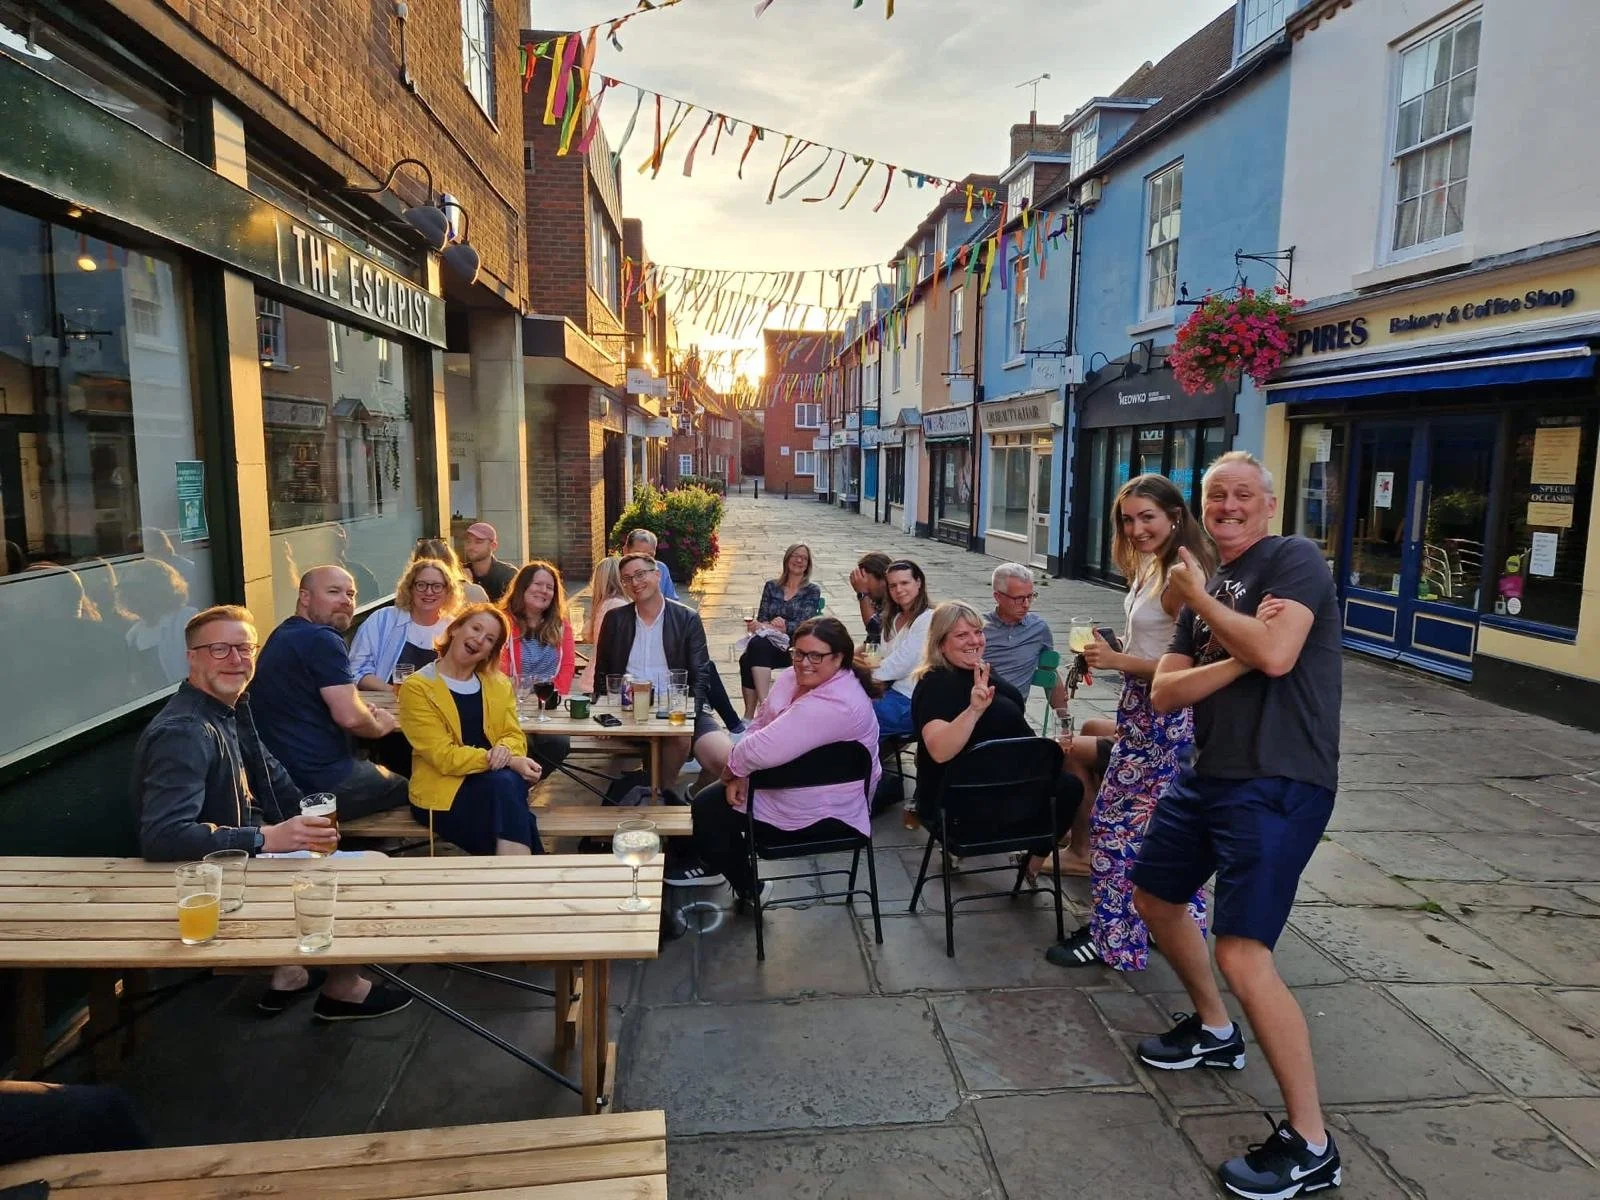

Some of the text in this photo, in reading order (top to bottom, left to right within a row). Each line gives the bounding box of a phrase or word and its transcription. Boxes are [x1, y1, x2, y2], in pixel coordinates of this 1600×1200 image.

[292, 225, 430, 337] THE ESCAPIST
[1389, 312, 1444, 333] Bakery
[1446, 305, 1459, 324] &
[1462, 297, 1521, 321] Coffee
[1524, 288, 1575, 309] Shop
